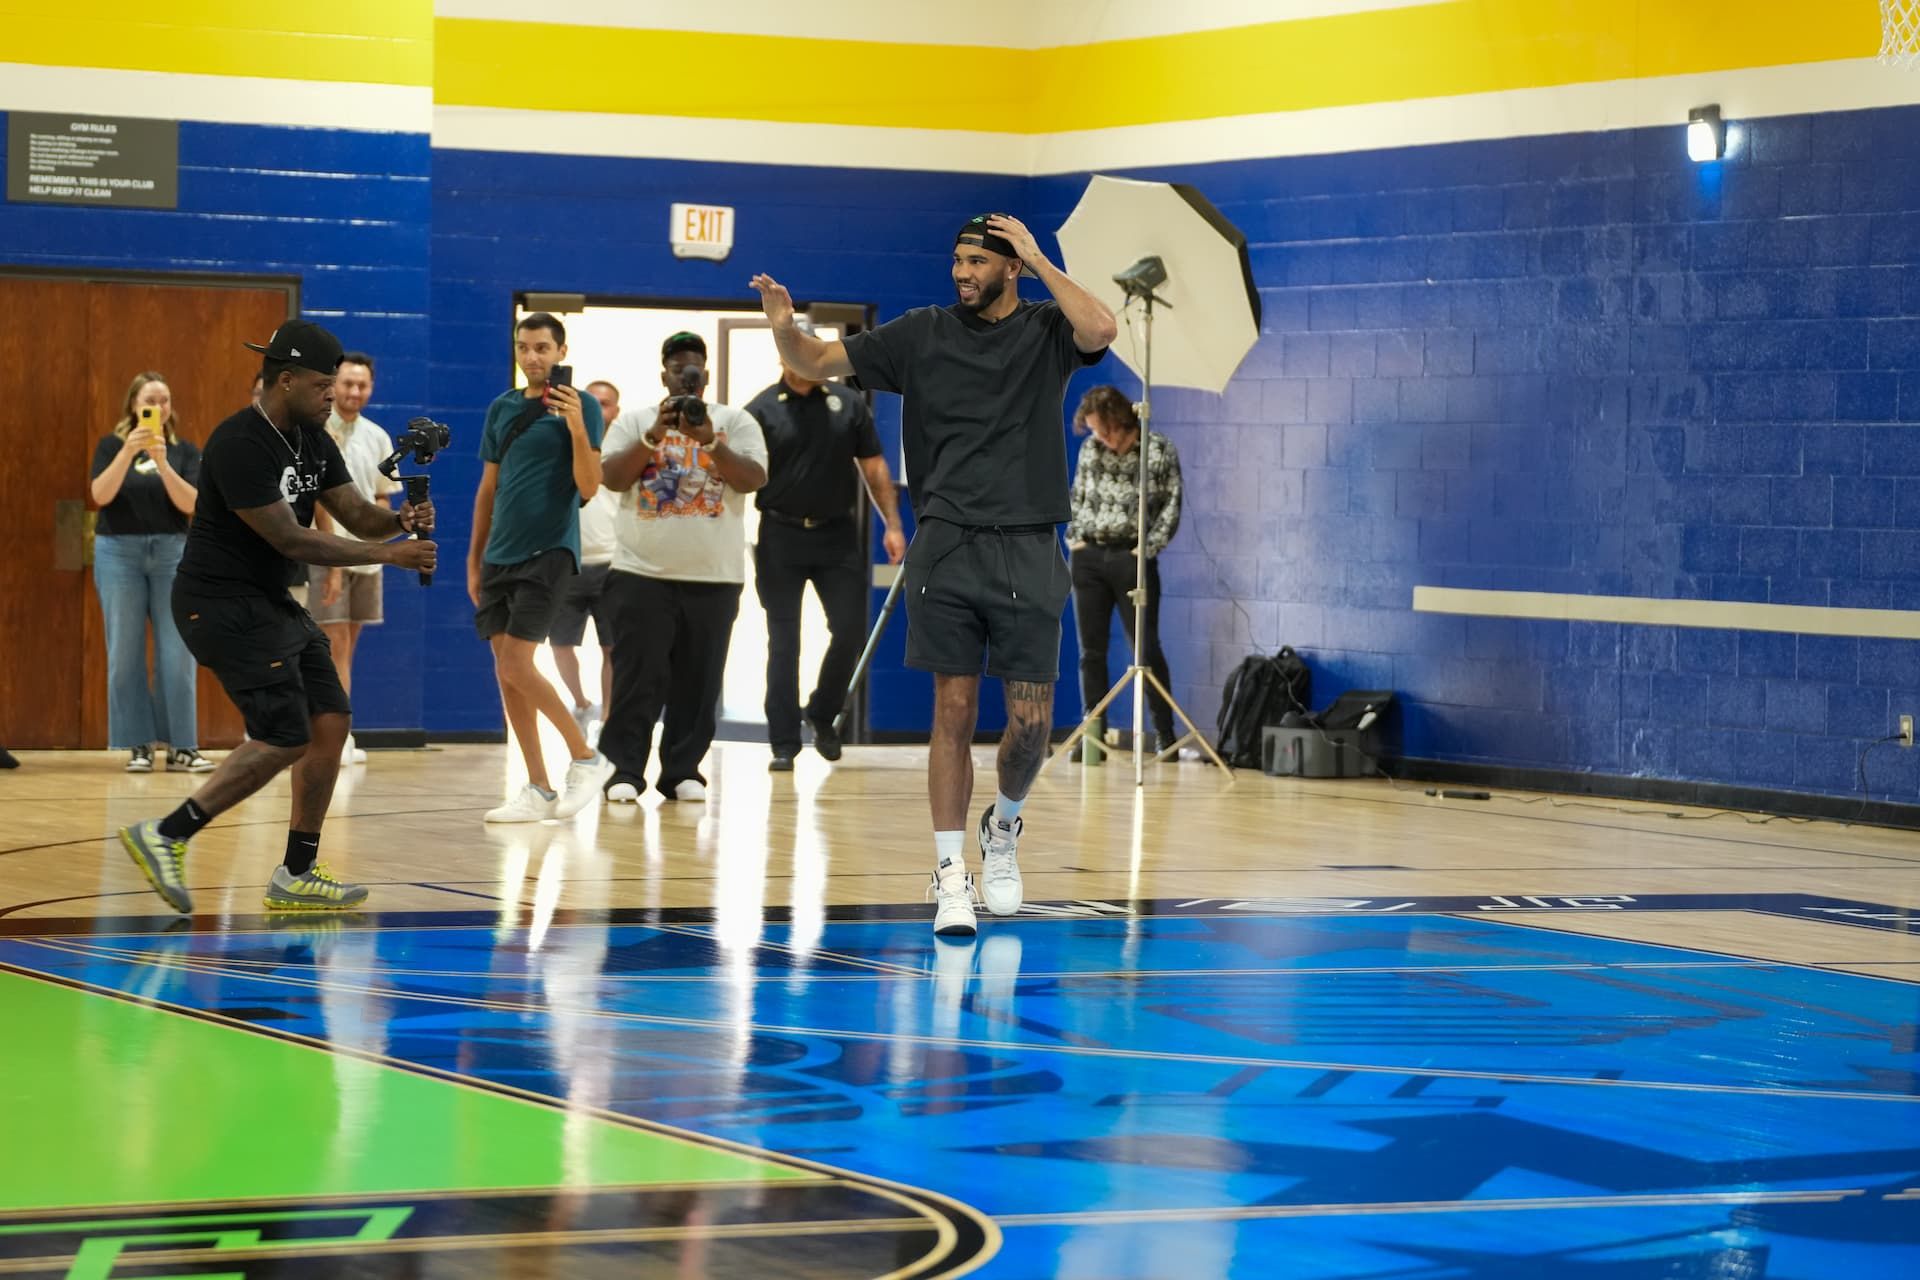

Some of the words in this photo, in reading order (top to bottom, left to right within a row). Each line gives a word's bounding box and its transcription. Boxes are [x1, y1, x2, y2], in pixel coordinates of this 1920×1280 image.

[71, 122, 91, 132] GYM
[92, 124, 117, 134] RULES
[79, 177, 98, 186] THIS
[99, 178, 107, 187] IS
[108, 178, 131, 188] YOUR
[132, 180, 154, 189] CLUB
[29, 185, 51, 194] HELP
[52, 186, 74, 196] KEEP
[74, 187, 82, 196] IT
[83, 188, 111, 197] CLEAN
[685, 208, 725, 243] EXIT
